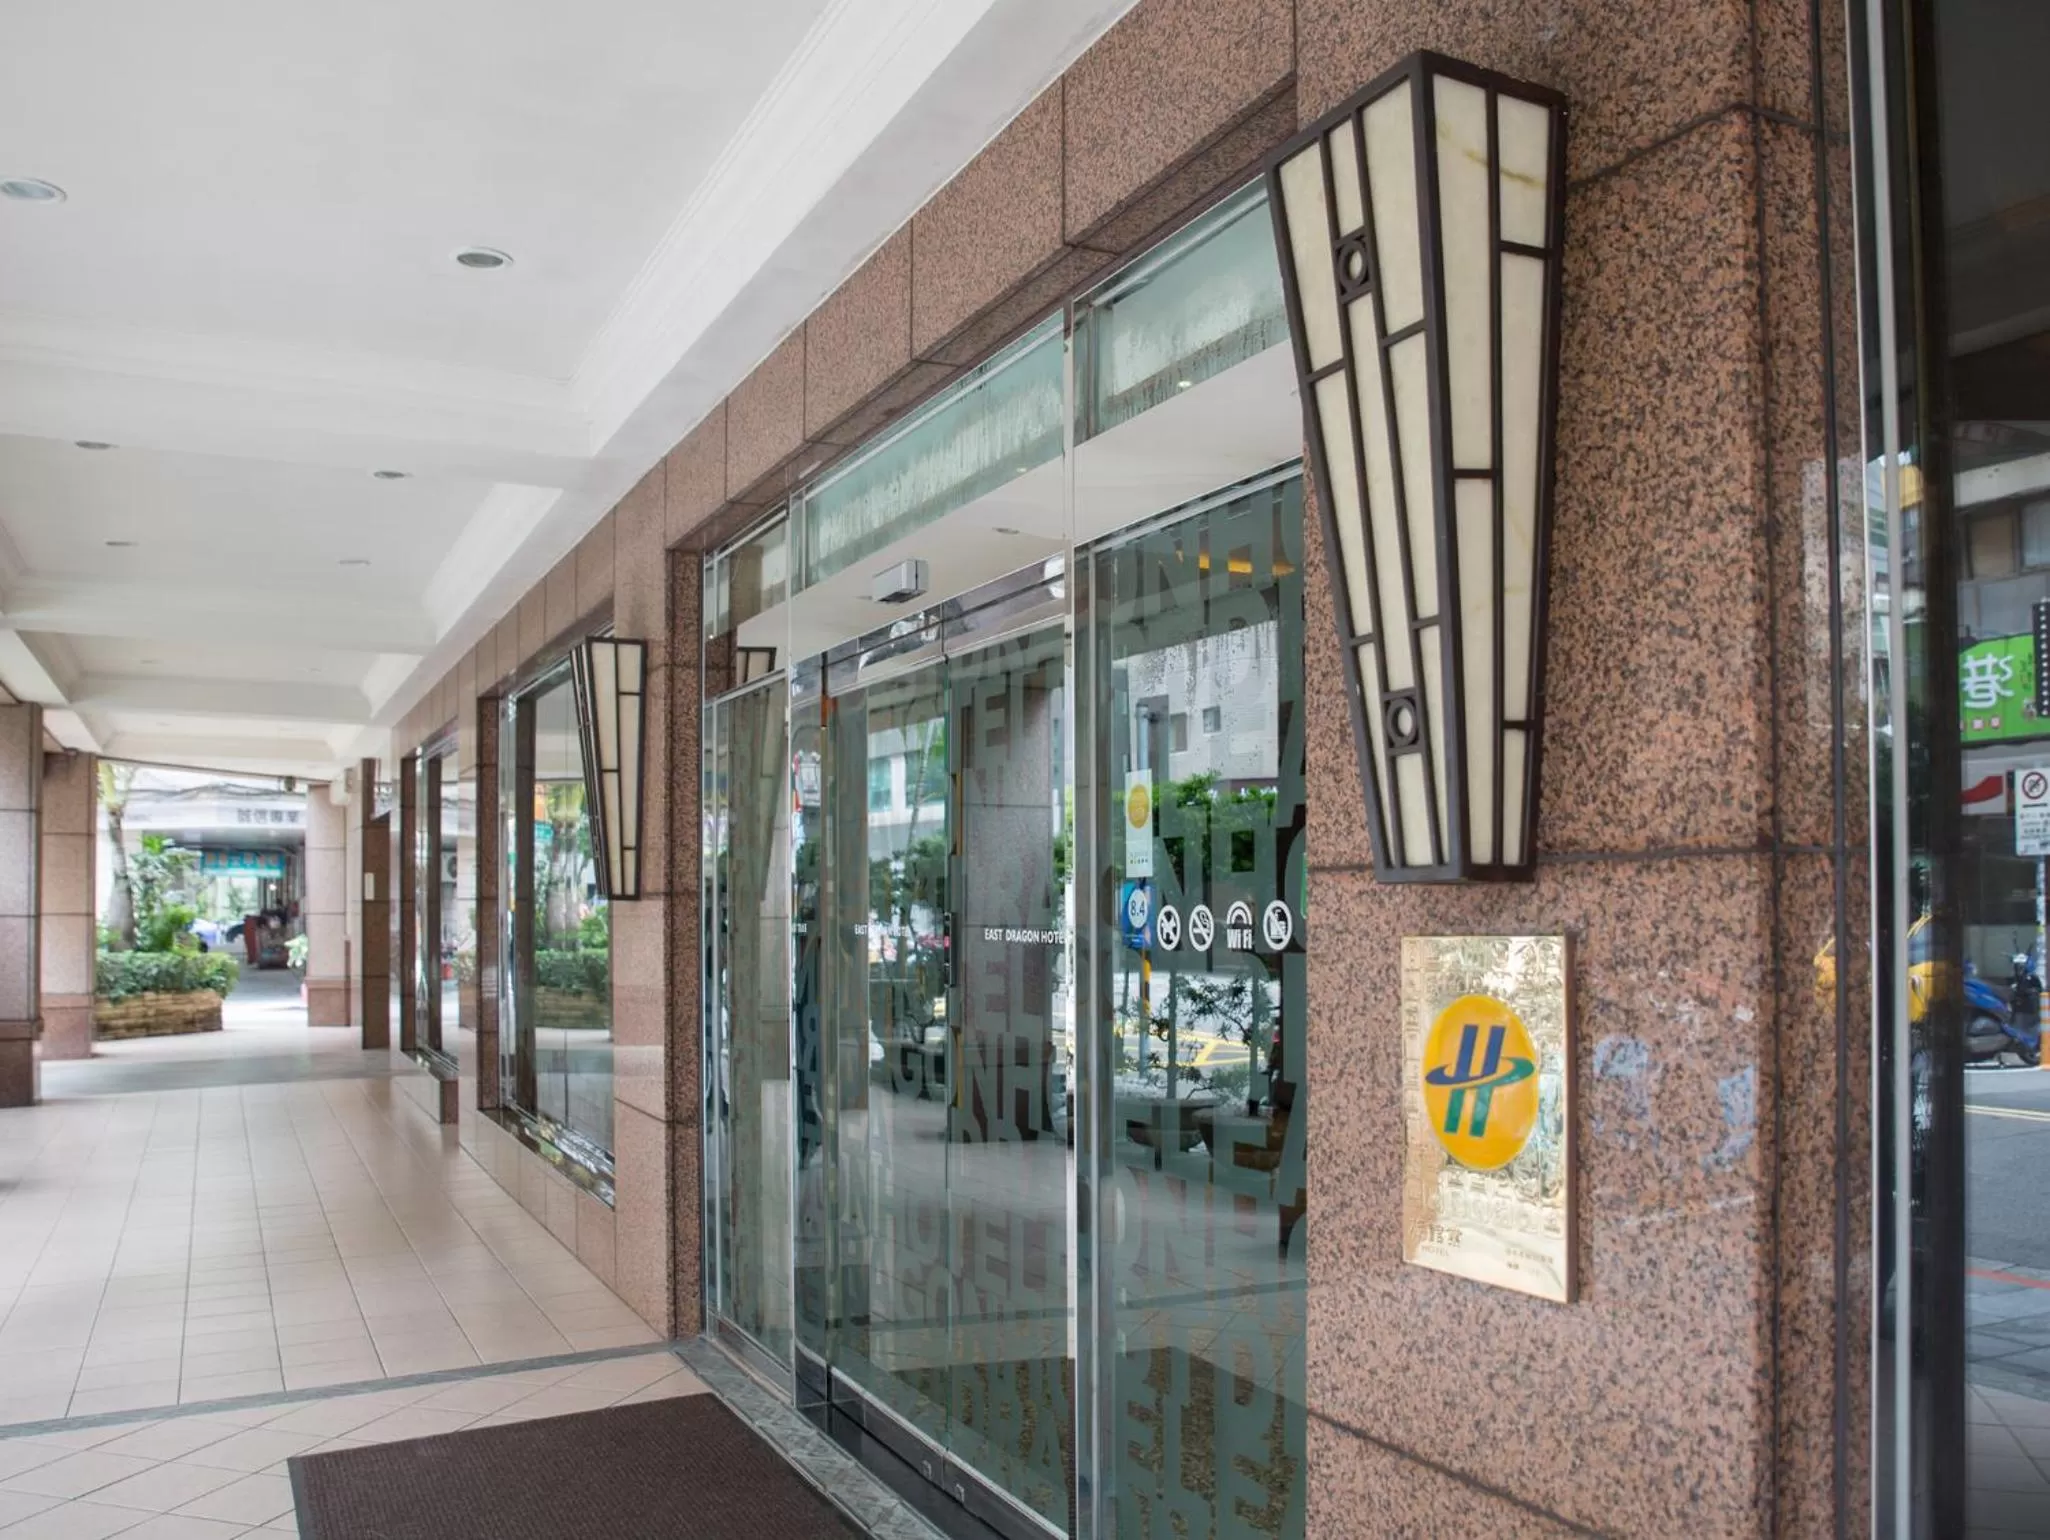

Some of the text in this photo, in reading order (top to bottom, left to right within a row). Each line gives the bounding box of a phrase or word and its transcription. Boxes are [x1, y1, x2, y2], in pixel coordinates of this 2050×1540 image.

[1131, 901, 1145, 916] 8.4
[984, 928, 1068, 945] EAST DRAGON HOTE
